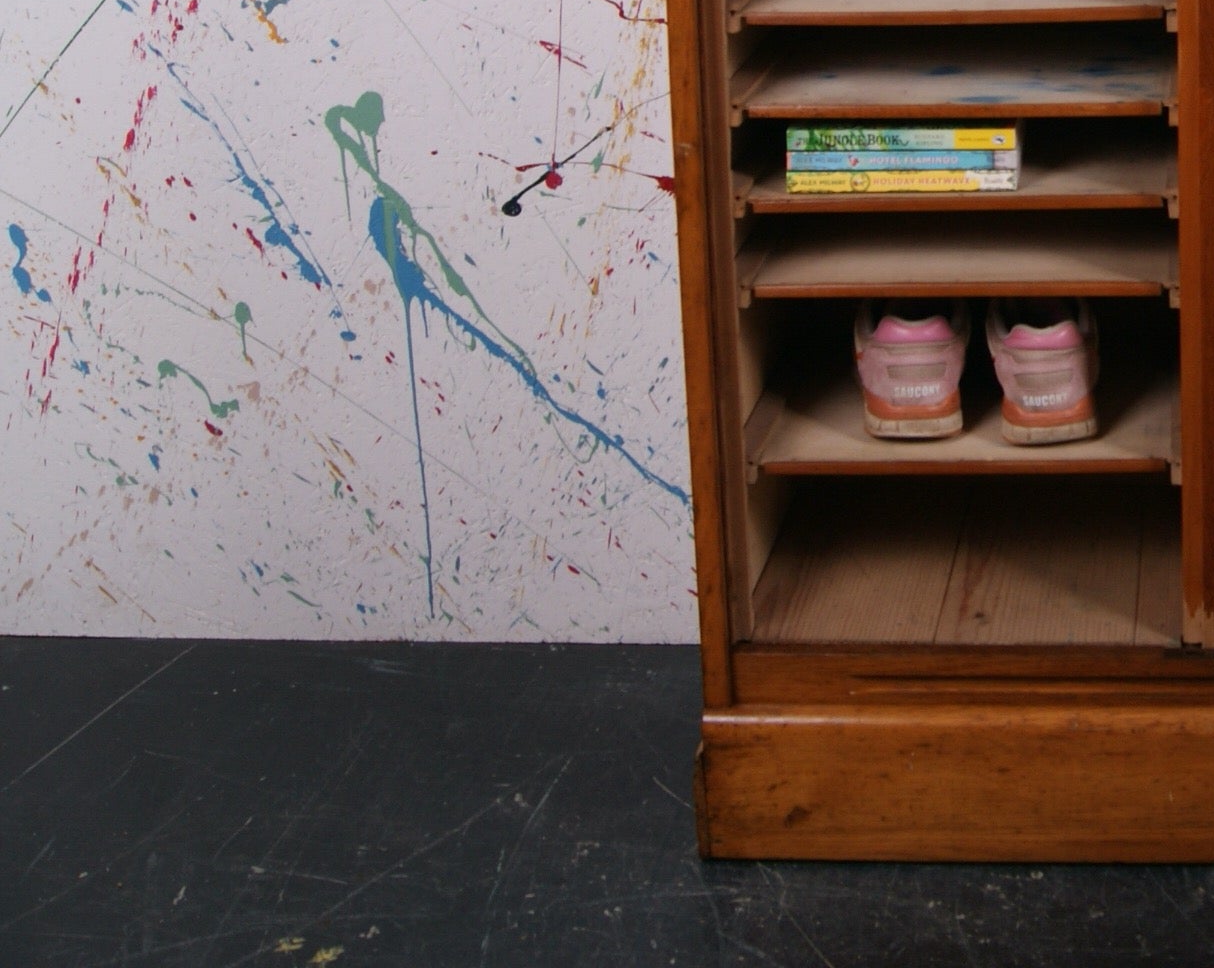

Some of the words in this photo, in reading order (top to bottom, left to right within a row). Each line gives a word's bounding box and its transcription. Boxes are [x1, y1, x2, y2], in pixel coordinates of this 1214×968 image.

[818, 133, 866, 147] JUNGLE
[866, 133, 904, 147] BOOK
[869, 156, 901, 164] HOTEL
[904, 156, 959, 165] FLAMINGO
[873, 177, 916, 186] HOLIDAY
[919, 176, 970, 185] HEATWAVE
[894, 383, 941, 398] SAUCONY
[1022, 392, 1068, 406] SAUCONY
